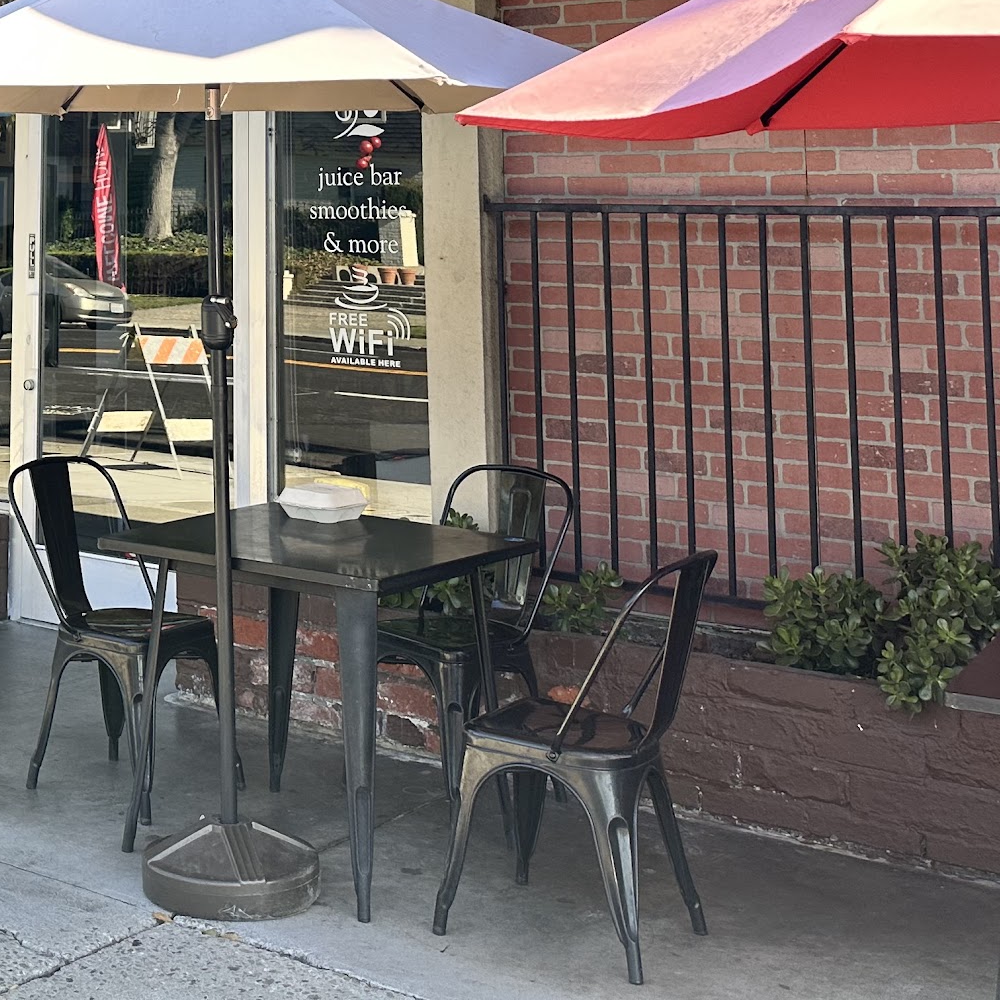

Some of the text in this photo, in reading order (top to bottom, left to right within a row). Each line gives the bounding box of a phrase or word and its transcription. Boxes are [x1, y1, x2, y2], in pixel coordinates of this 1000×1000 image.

[318, 163, 402, 192] juice bar
[309, 196, 407, 220] smoothies
[323, 231, 399, 254] & more
[329, 312, 368, 327] FREE
[328, 326, 395, 357] WiFi
[330, 356, 401, 368] AVAILABLE HERE
